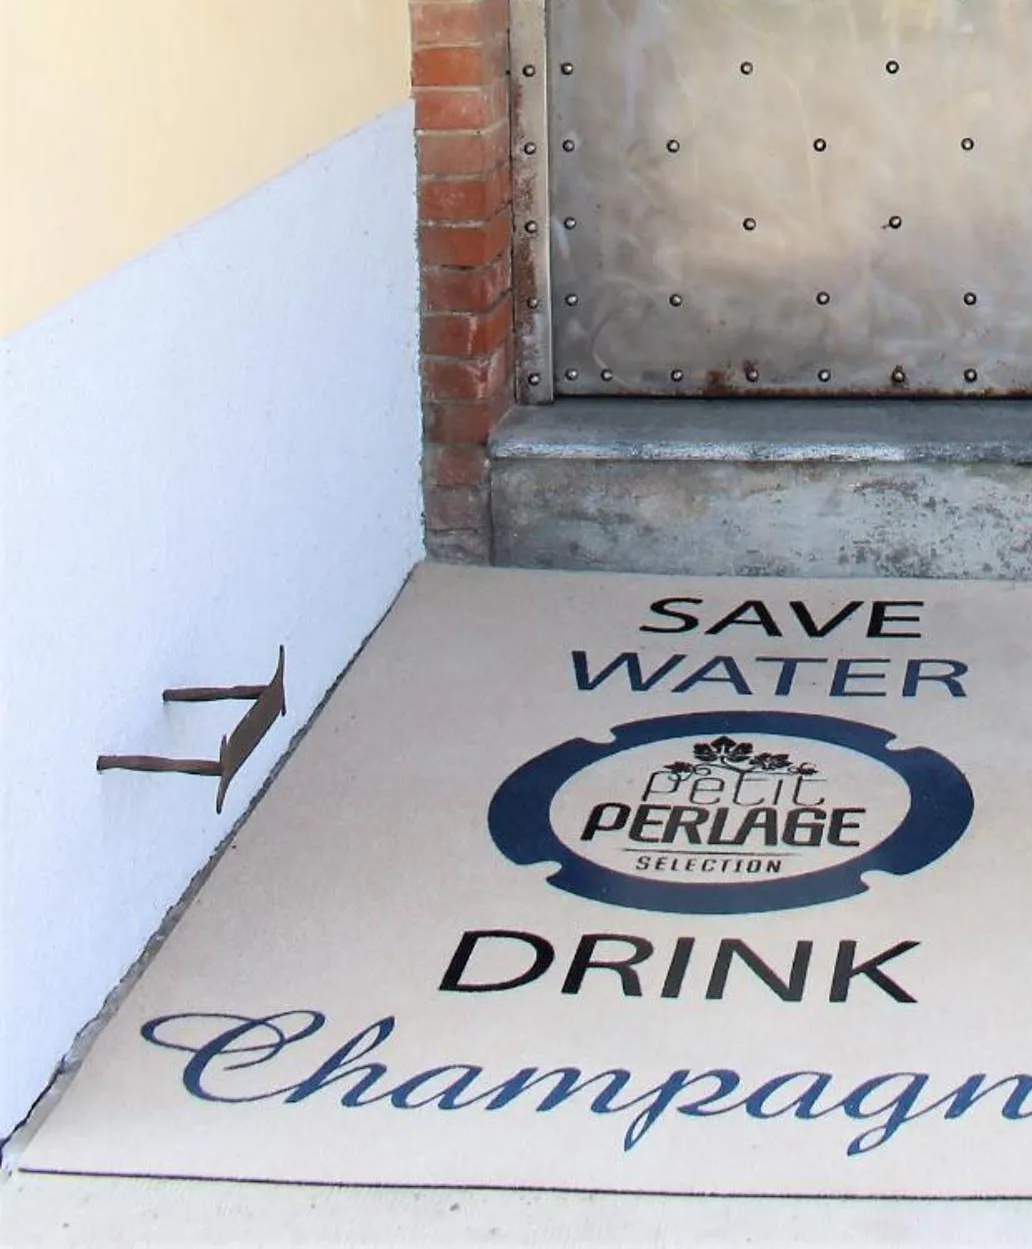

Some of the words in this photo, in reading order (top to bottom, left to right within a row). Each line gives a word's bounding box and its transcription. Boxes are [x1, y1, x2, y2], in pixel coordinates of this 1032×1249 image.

[639, 597, 924, 639] SAVE
[571, 650, 969, 698] WATER
[579, 802, 867, 848] PERLAGE
[636, 855, 783, 874] SELECTION
[438, 929, 921, 1004] DRINK
